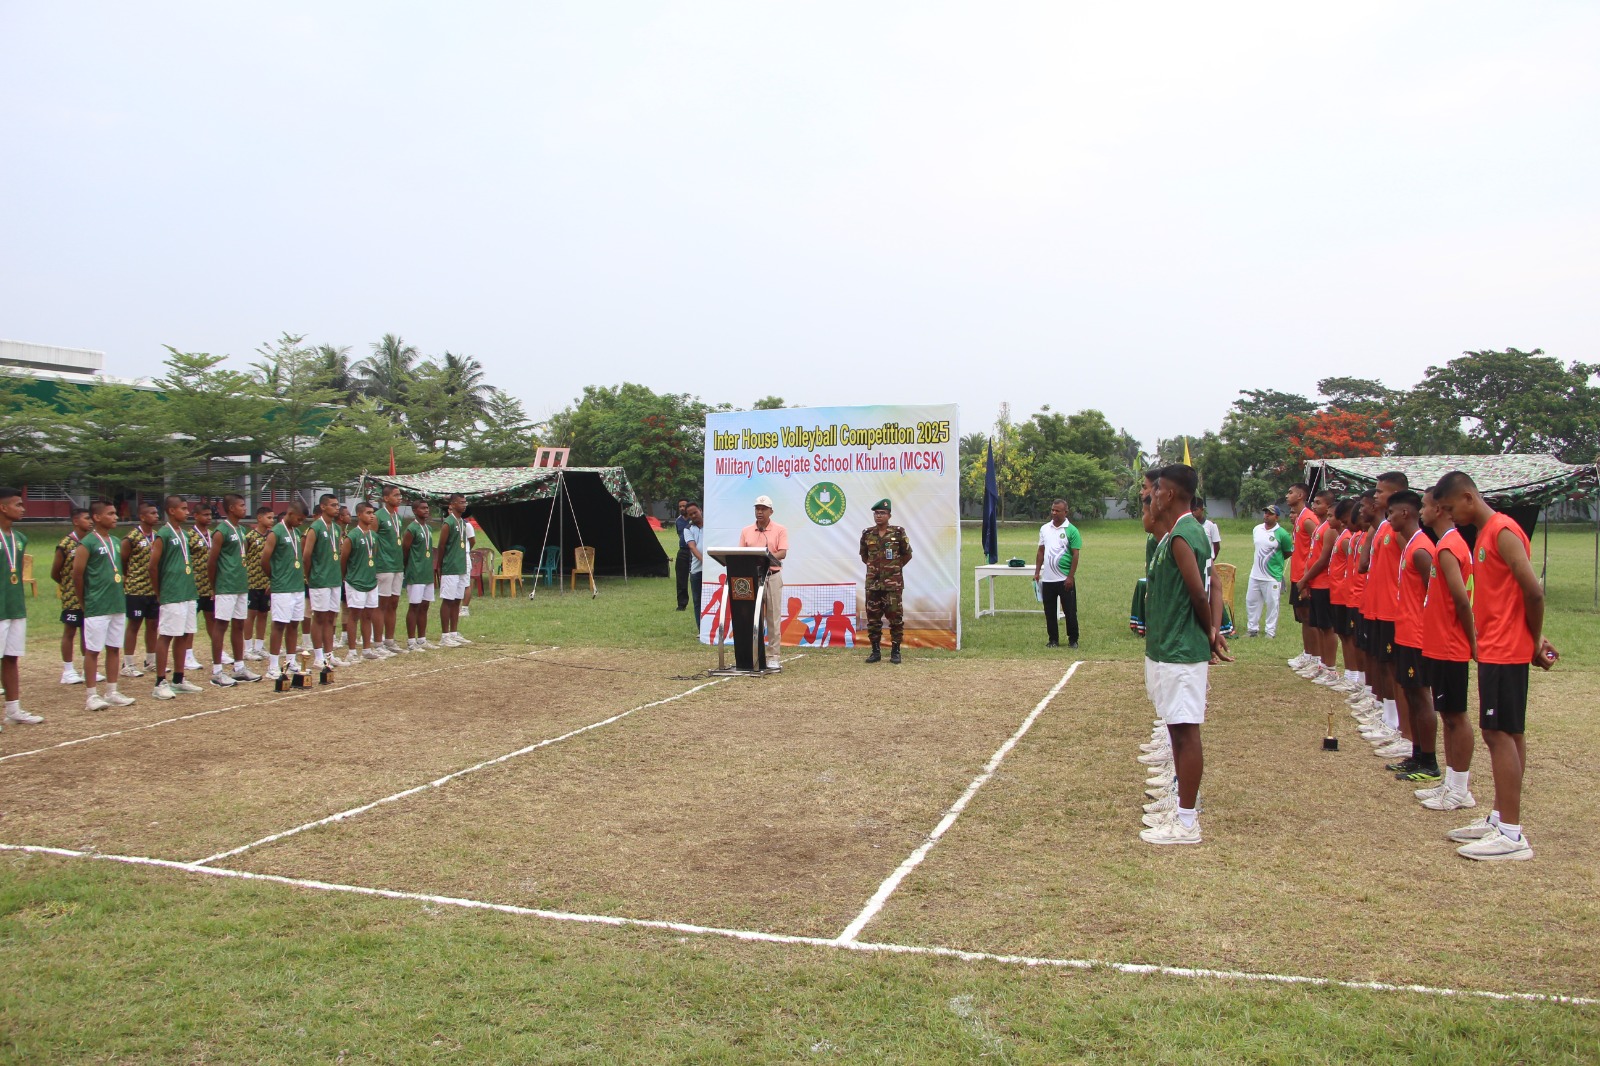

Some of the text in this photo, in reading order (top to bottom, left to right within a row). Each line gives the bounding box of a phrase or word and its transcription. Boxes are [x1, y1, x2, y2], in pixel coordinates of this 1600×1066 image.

[714, 421, 950, 452] Inter House Volleyball Competition 2025
[716, 451, 945, 478] Military Collegiate School Khulna (MCSK)
[66, 613, 77, 621] 25
